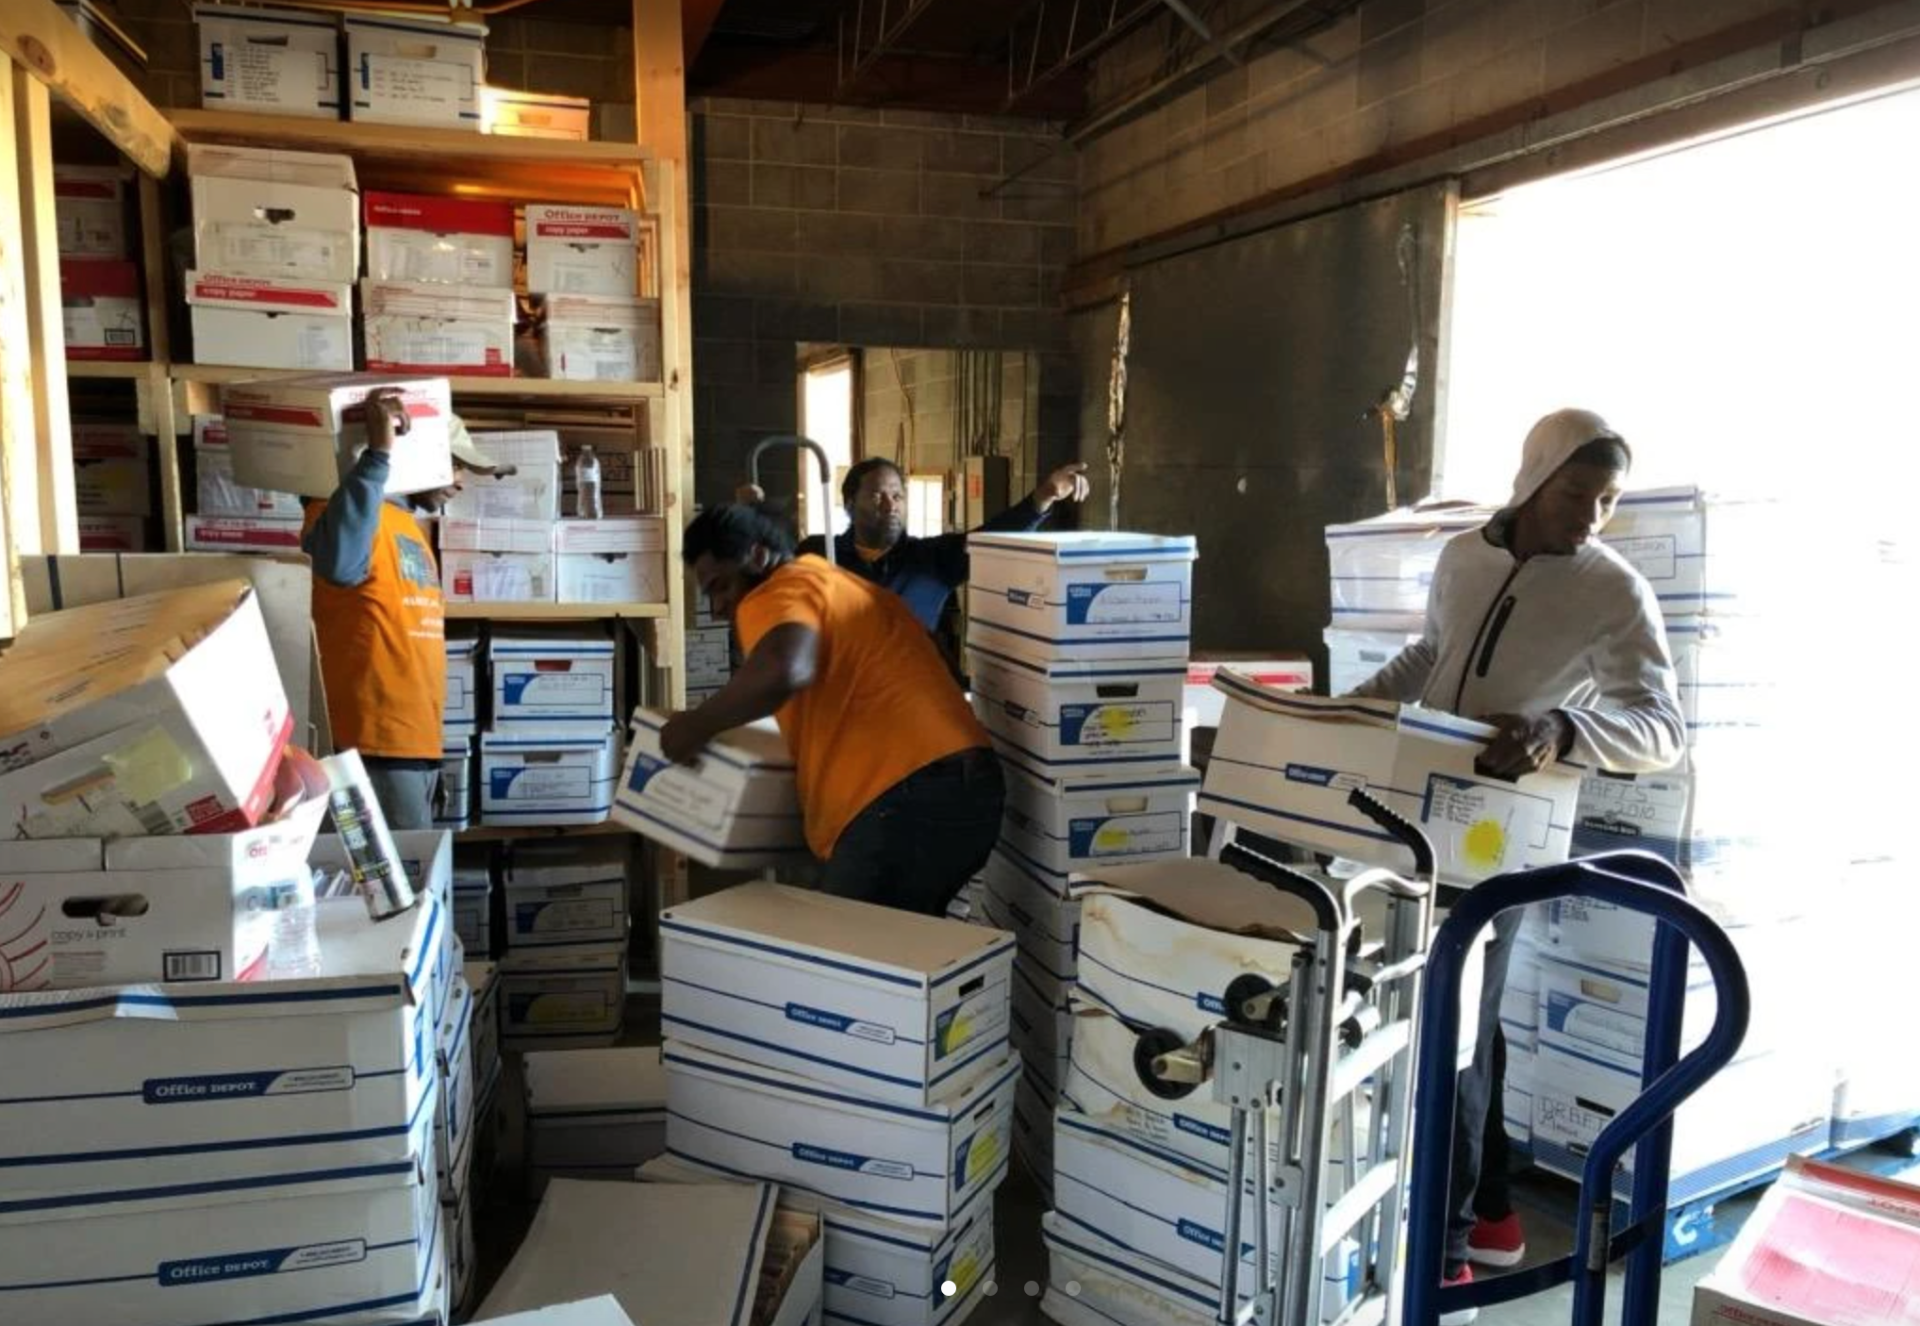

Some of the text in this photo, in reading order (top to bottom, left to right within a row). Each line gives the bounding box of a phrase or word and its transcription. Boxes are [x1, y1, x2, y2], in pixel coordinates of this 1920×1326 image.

[545, 209, 583, 221] Office
[155, 1081, 256, 1097] Office DEPOT
[170, 1259, 269, 1280] Office DEPOT
